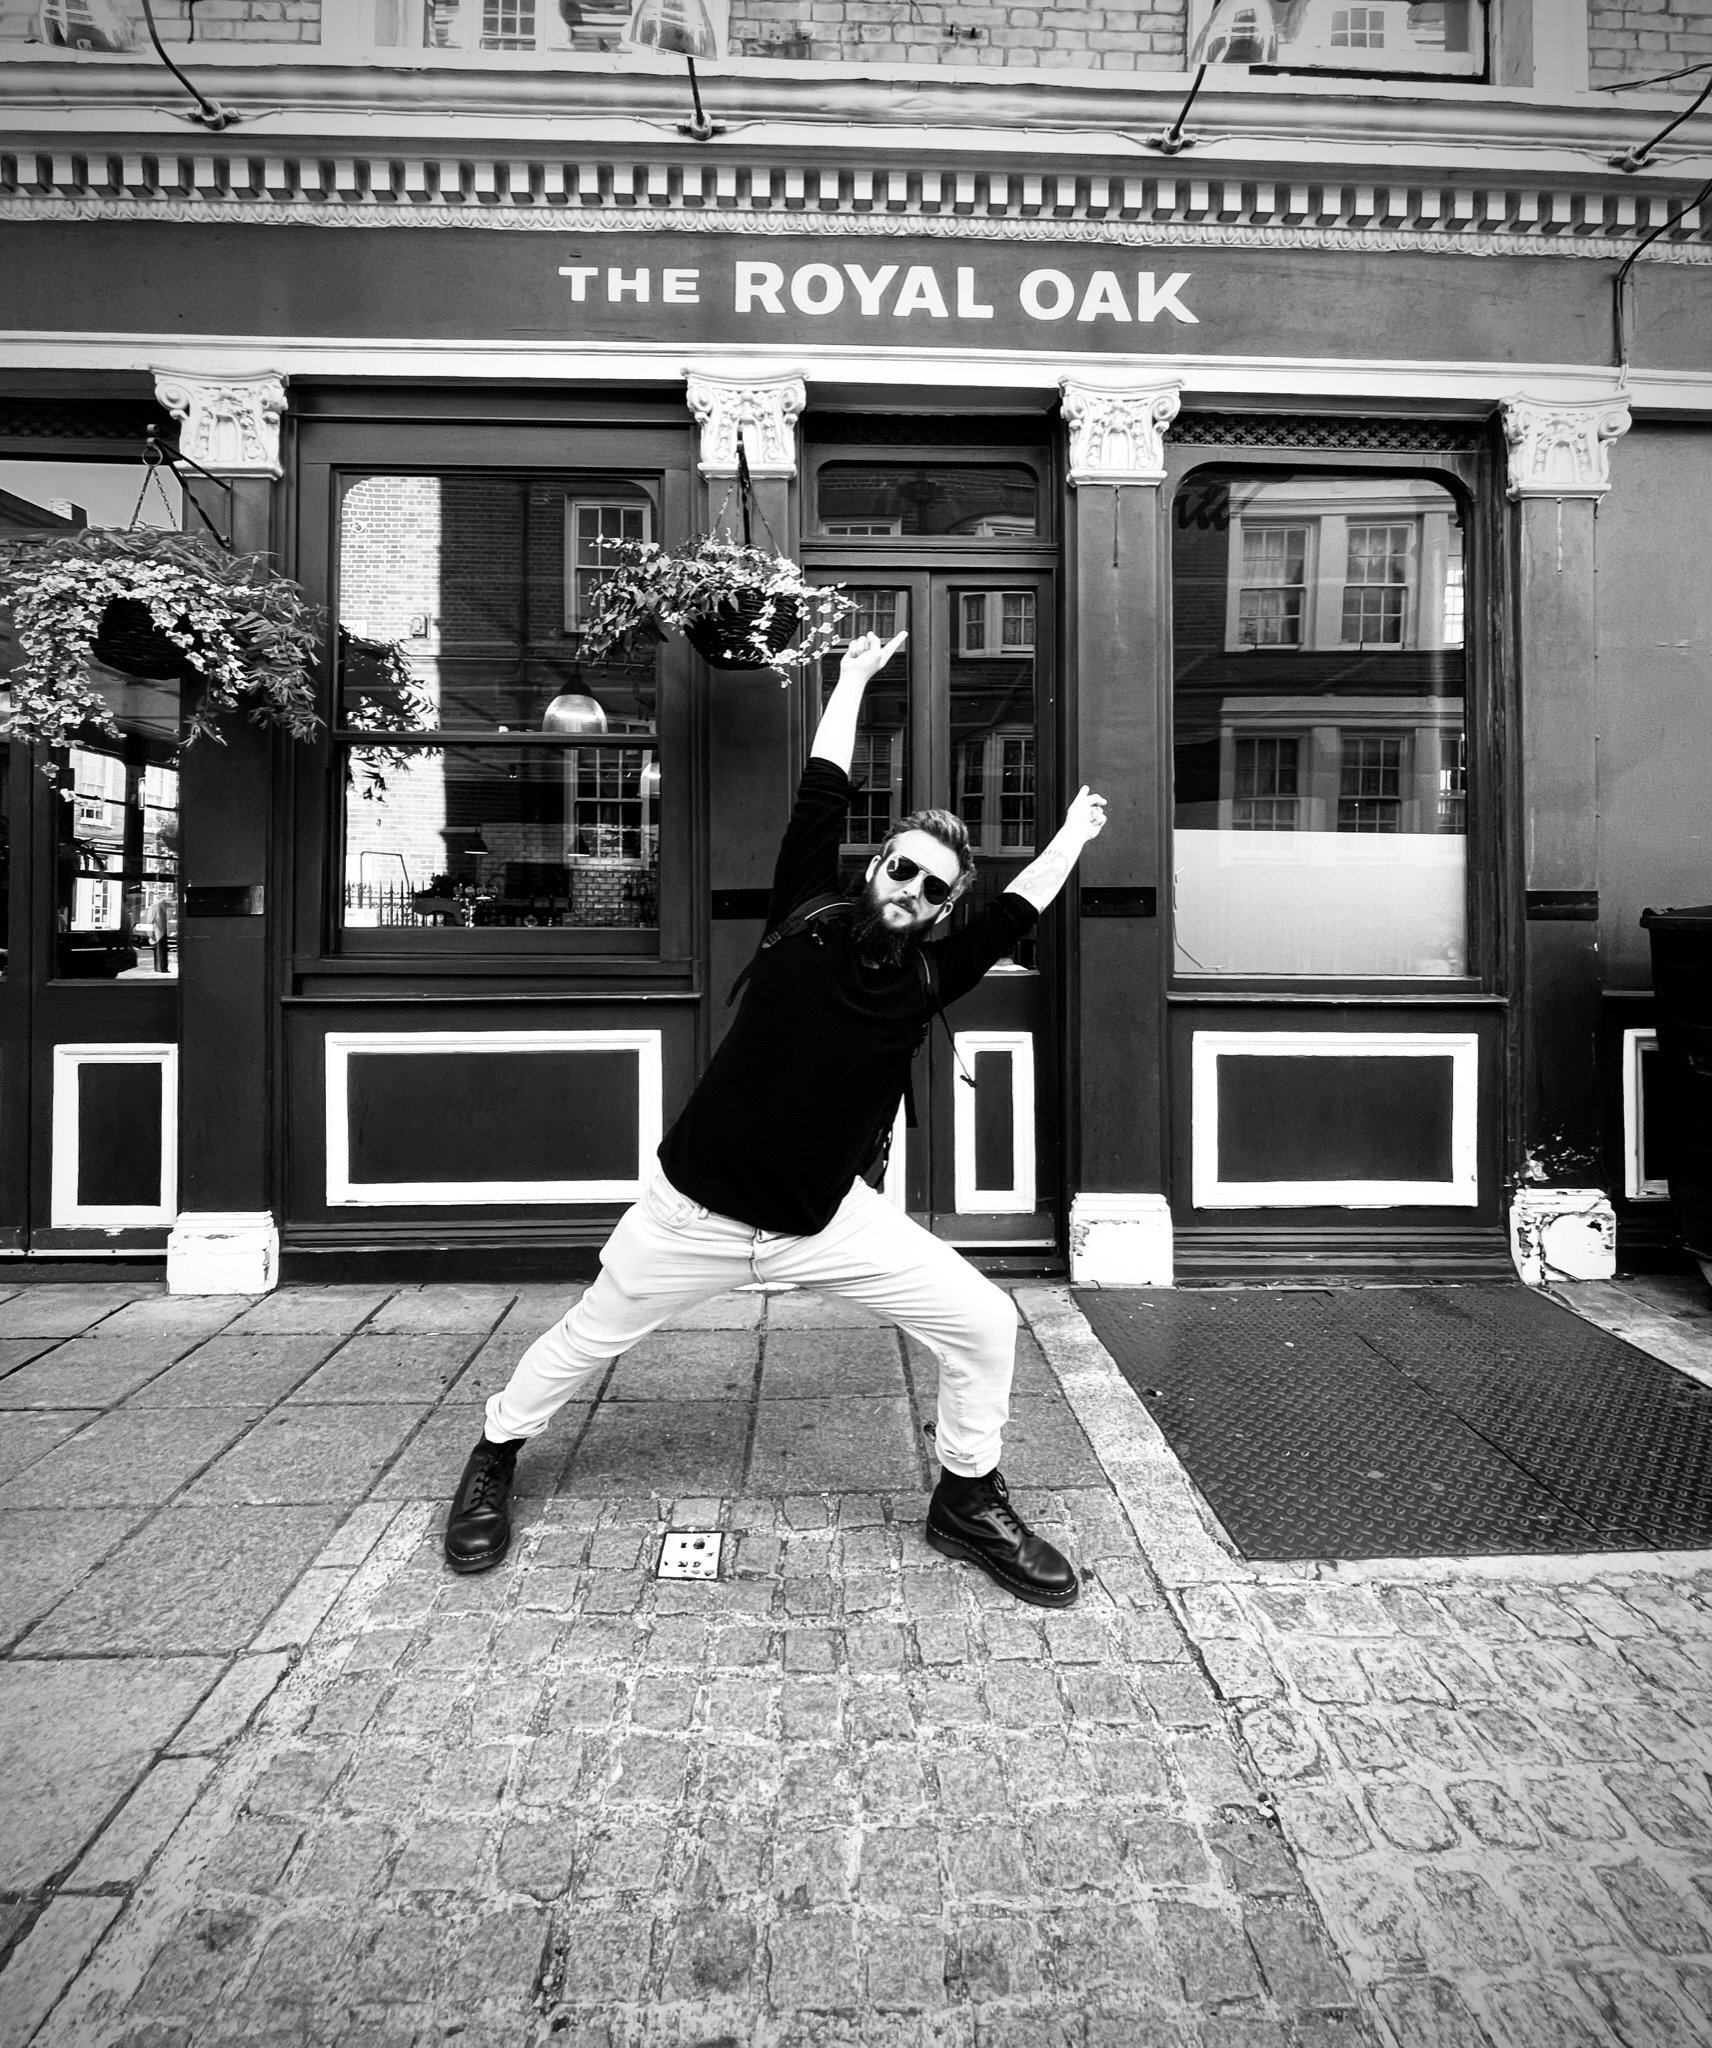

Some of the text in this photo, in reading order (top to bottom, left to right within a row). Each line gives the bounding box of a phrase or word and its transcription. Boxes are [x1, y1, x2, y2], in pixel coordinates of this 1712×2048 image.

[558, 260, 1200, 324] THE ROYAL OAK
